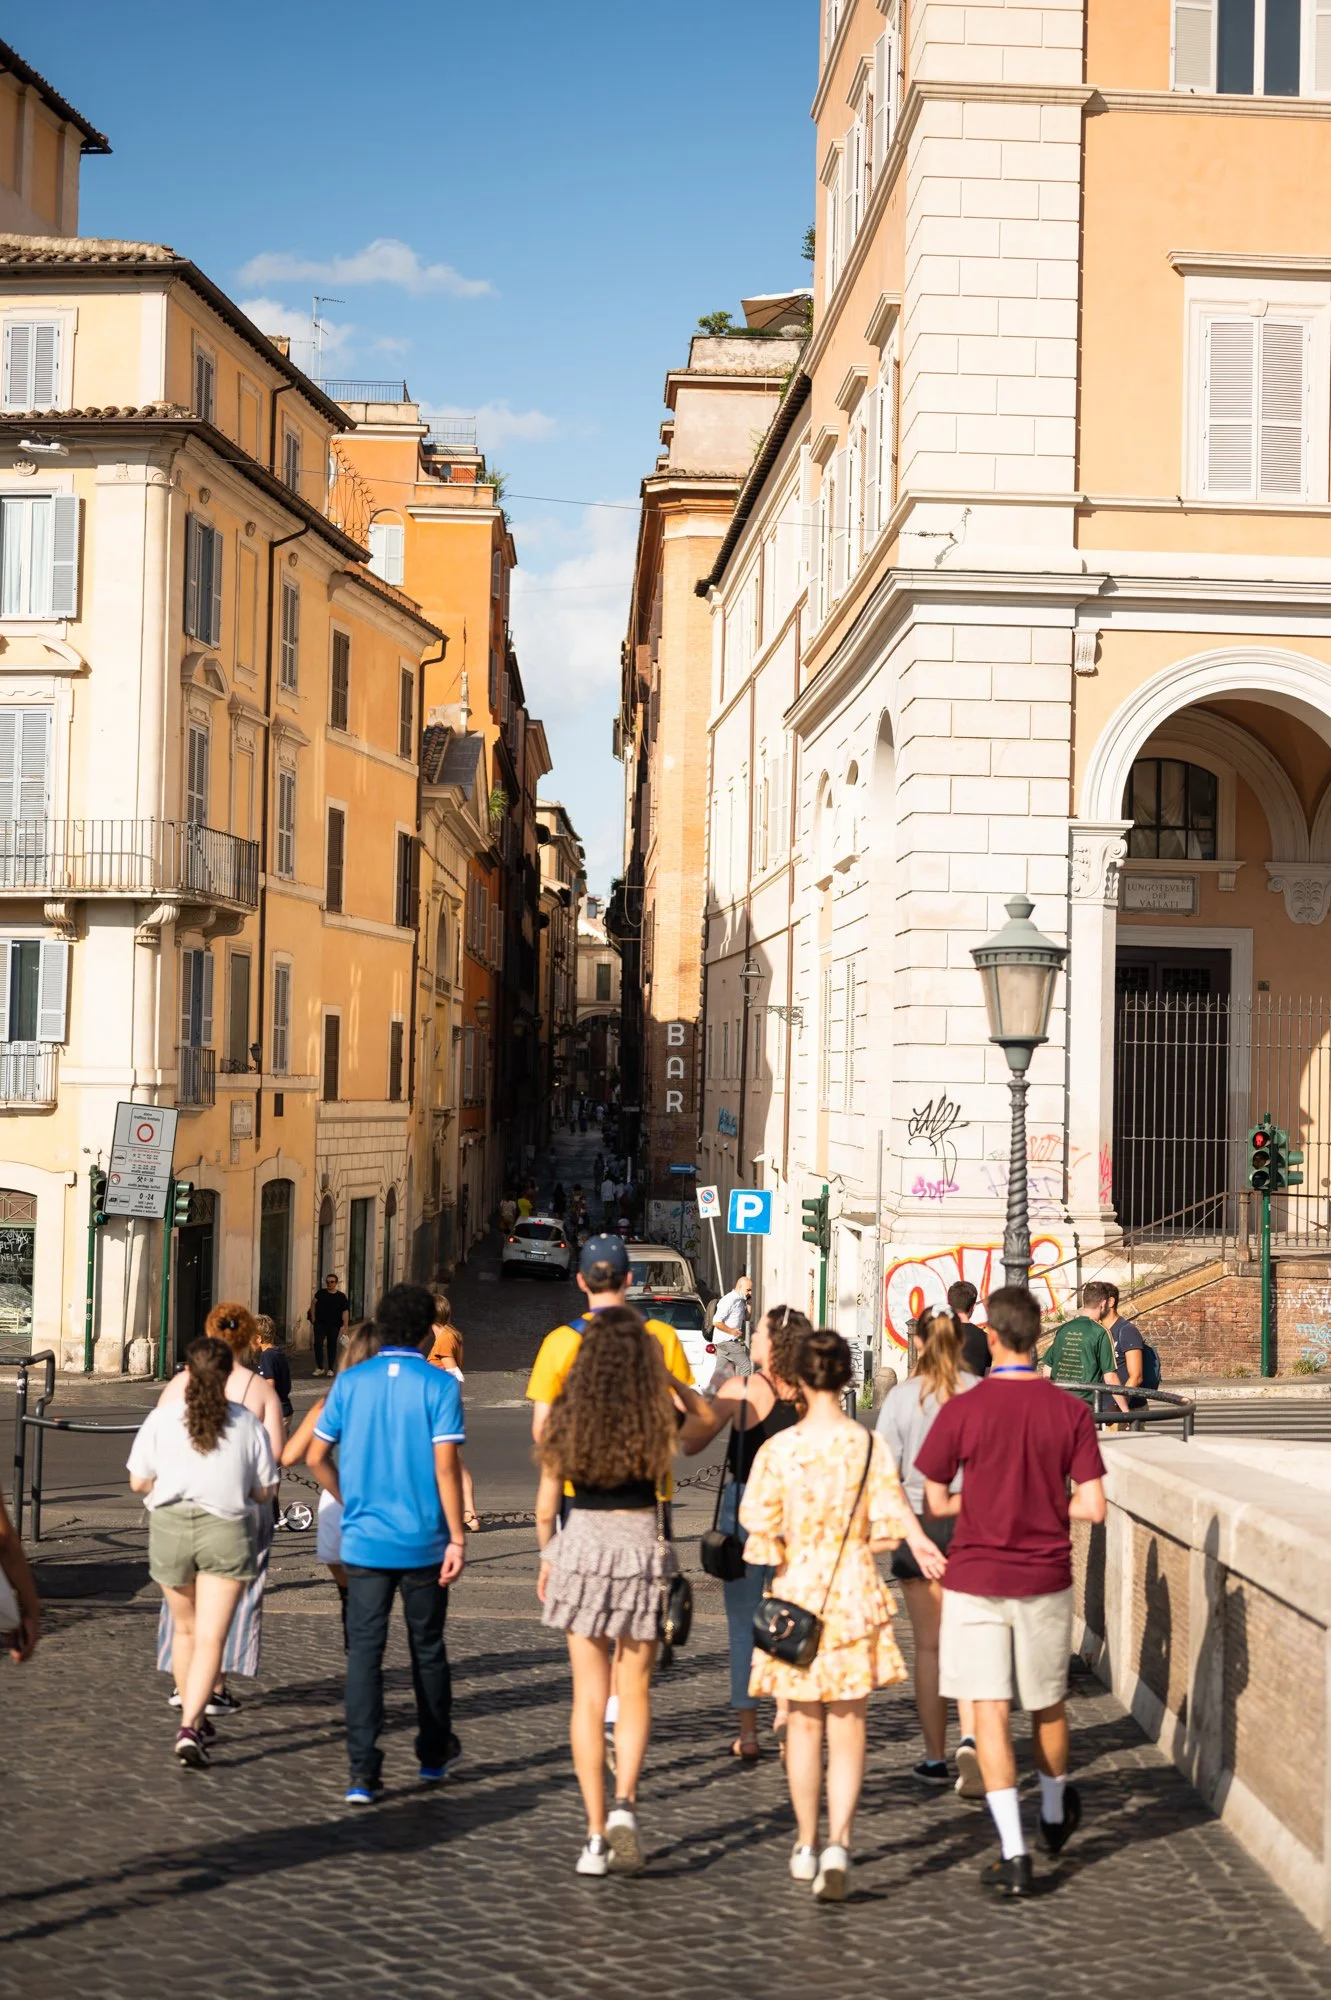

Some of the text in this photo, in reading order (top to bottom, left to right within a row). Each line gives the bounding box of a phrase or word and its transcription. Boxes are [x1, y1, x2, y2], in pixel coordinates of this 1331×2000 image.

[1127, 883, 1191, 892] LUNGOTEVERE
[1139, 899, 1179, 908] VALLATI
[666, 1022, 685, 1113] BAR
[735, 1193, 764, 1230] P
